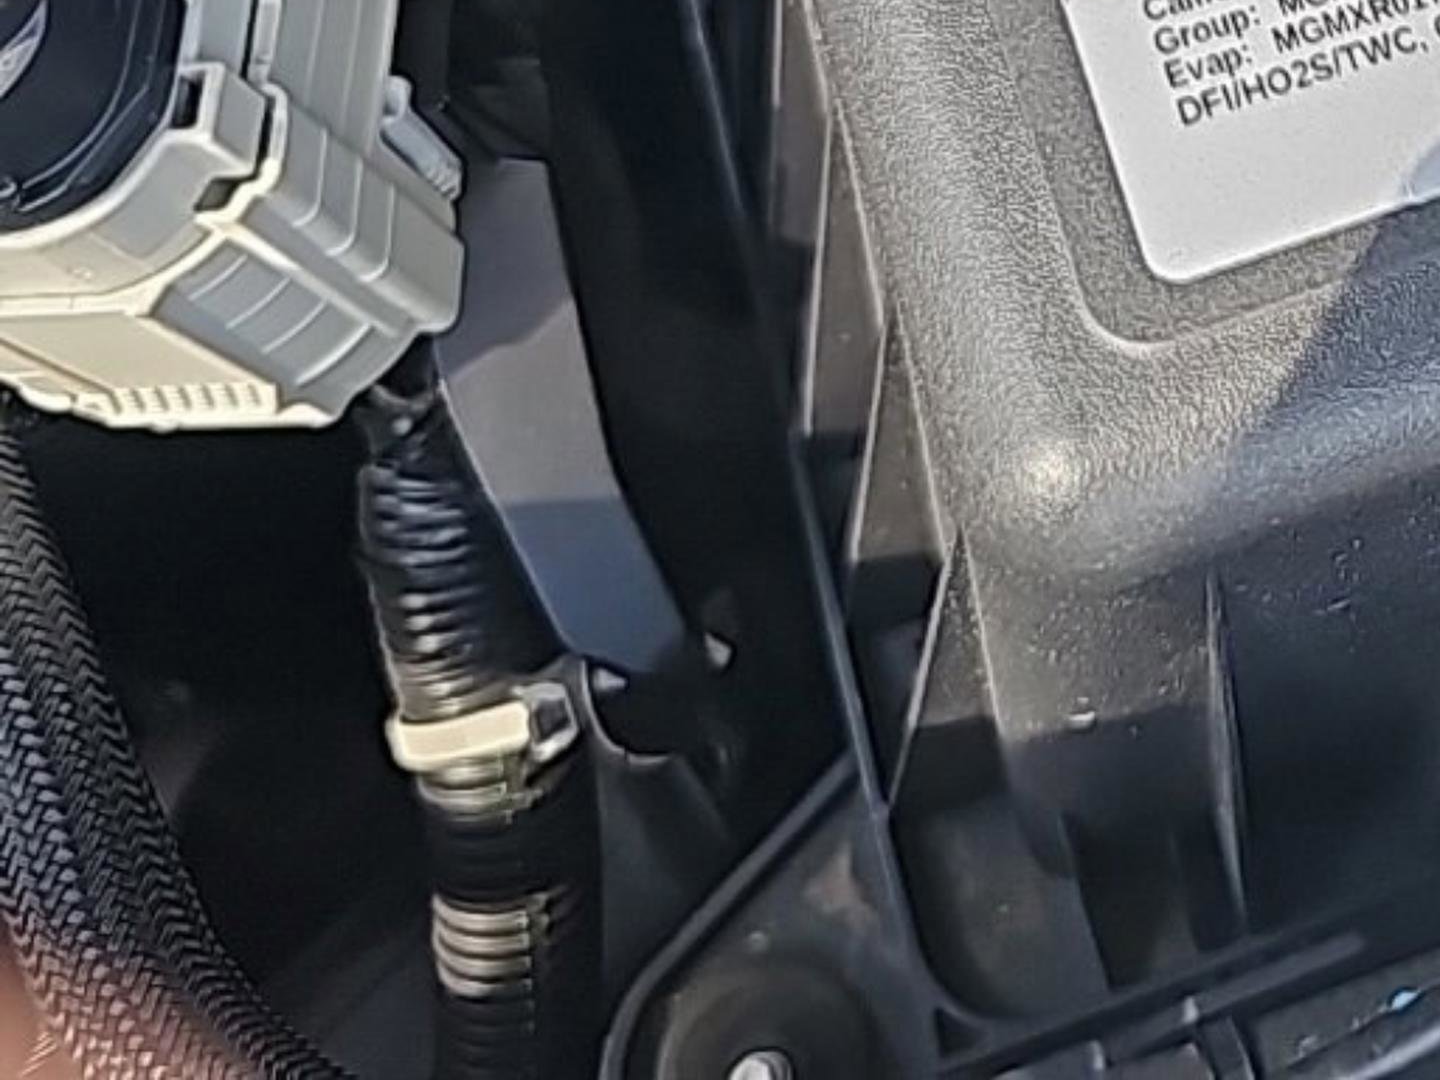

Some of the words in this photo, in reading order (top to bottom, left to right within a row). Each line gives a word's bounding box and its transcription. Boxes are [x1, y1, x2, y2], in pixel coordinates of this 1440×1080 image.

[1153, 5, 1261, 55] Group:
[1164, 44, 1252, 88] Evap:
[1177, 27, 1429, 125] DFI/HO2S/TWC,
